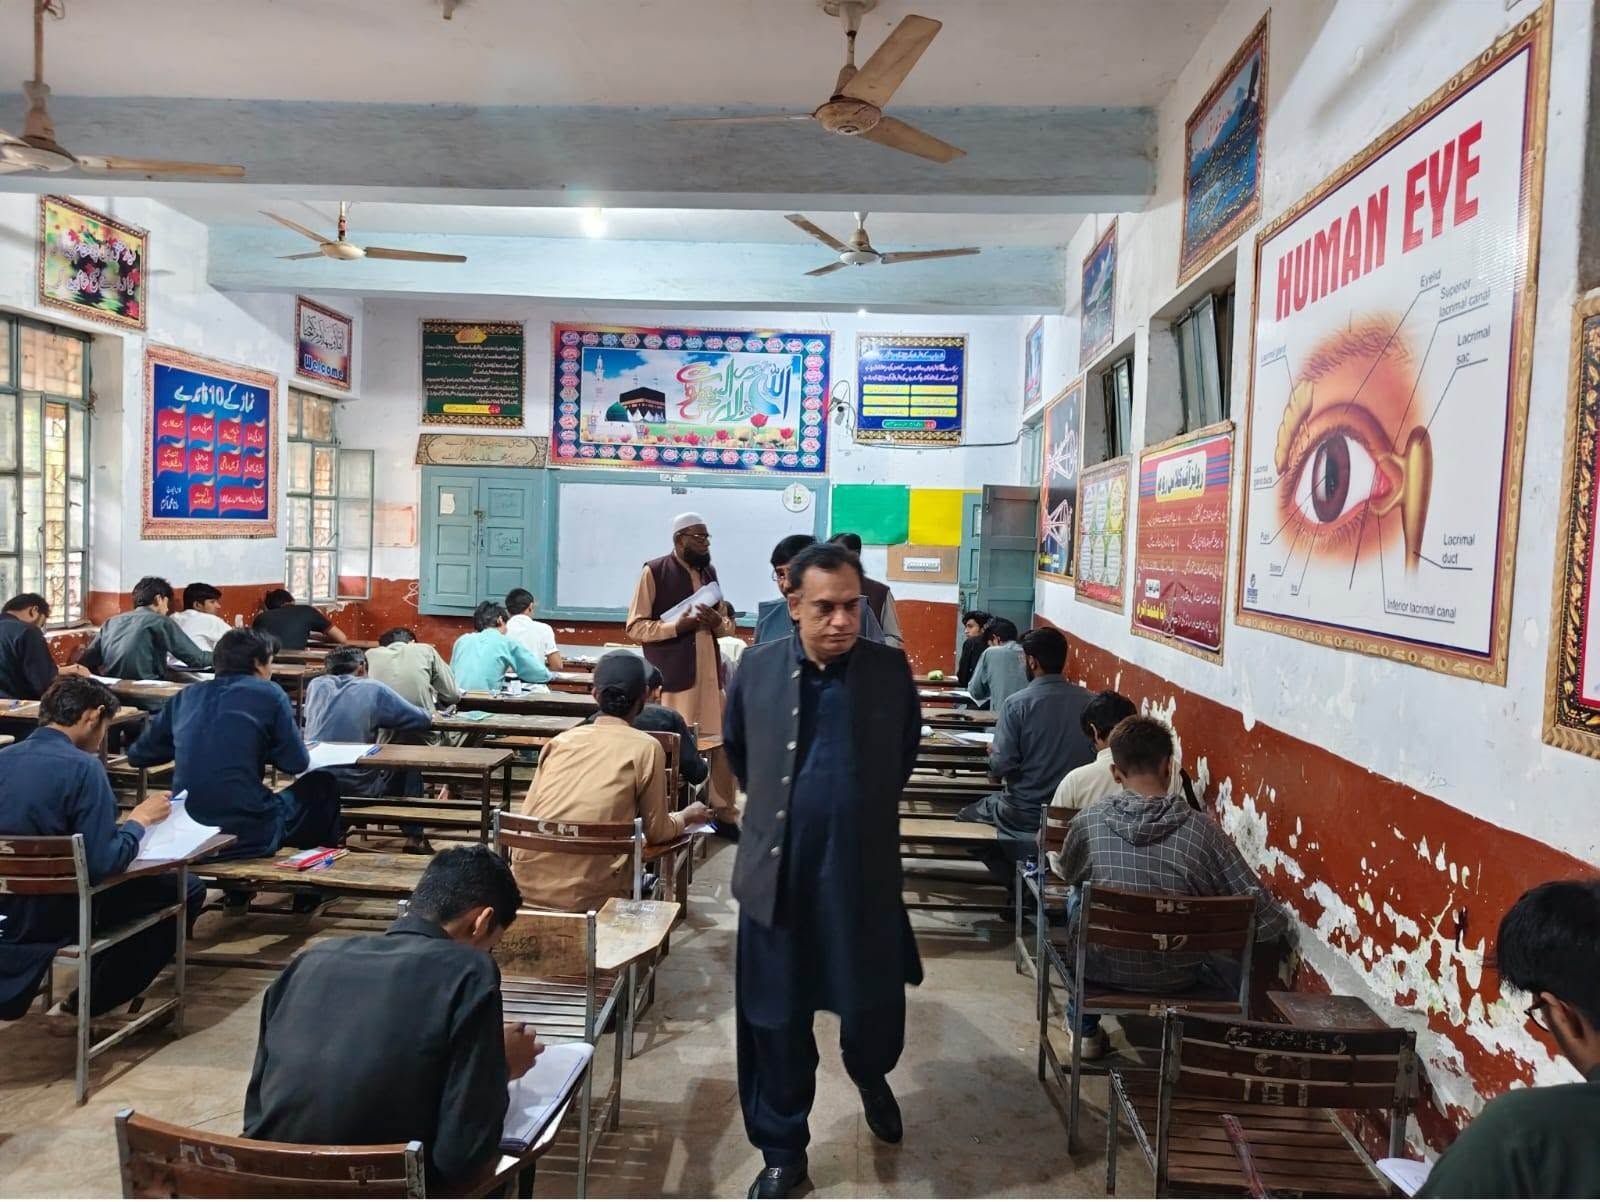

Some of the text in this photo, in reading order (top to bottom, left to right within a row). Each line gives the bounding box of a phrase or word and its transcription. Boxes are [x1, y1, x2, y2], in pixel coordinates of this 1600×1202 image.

[1276, 184, 1390, 323] HUMAN
[1402, 120, 1483, 254] EYE
[1440, 278, 1471, 300] Superior
[1457, 325, 1491, 347] Lacrimal
[303, 353, 344, 380] Welcome
[1456, 352, 1470, 365] sac
[239, 391, 255, 413] نماز
[1443, 534, 1475, 546] Lacrimal
[1442, 552, 1458, 564] duct
[1387, 599, 1456, 618] Inferior lacrimal canal
